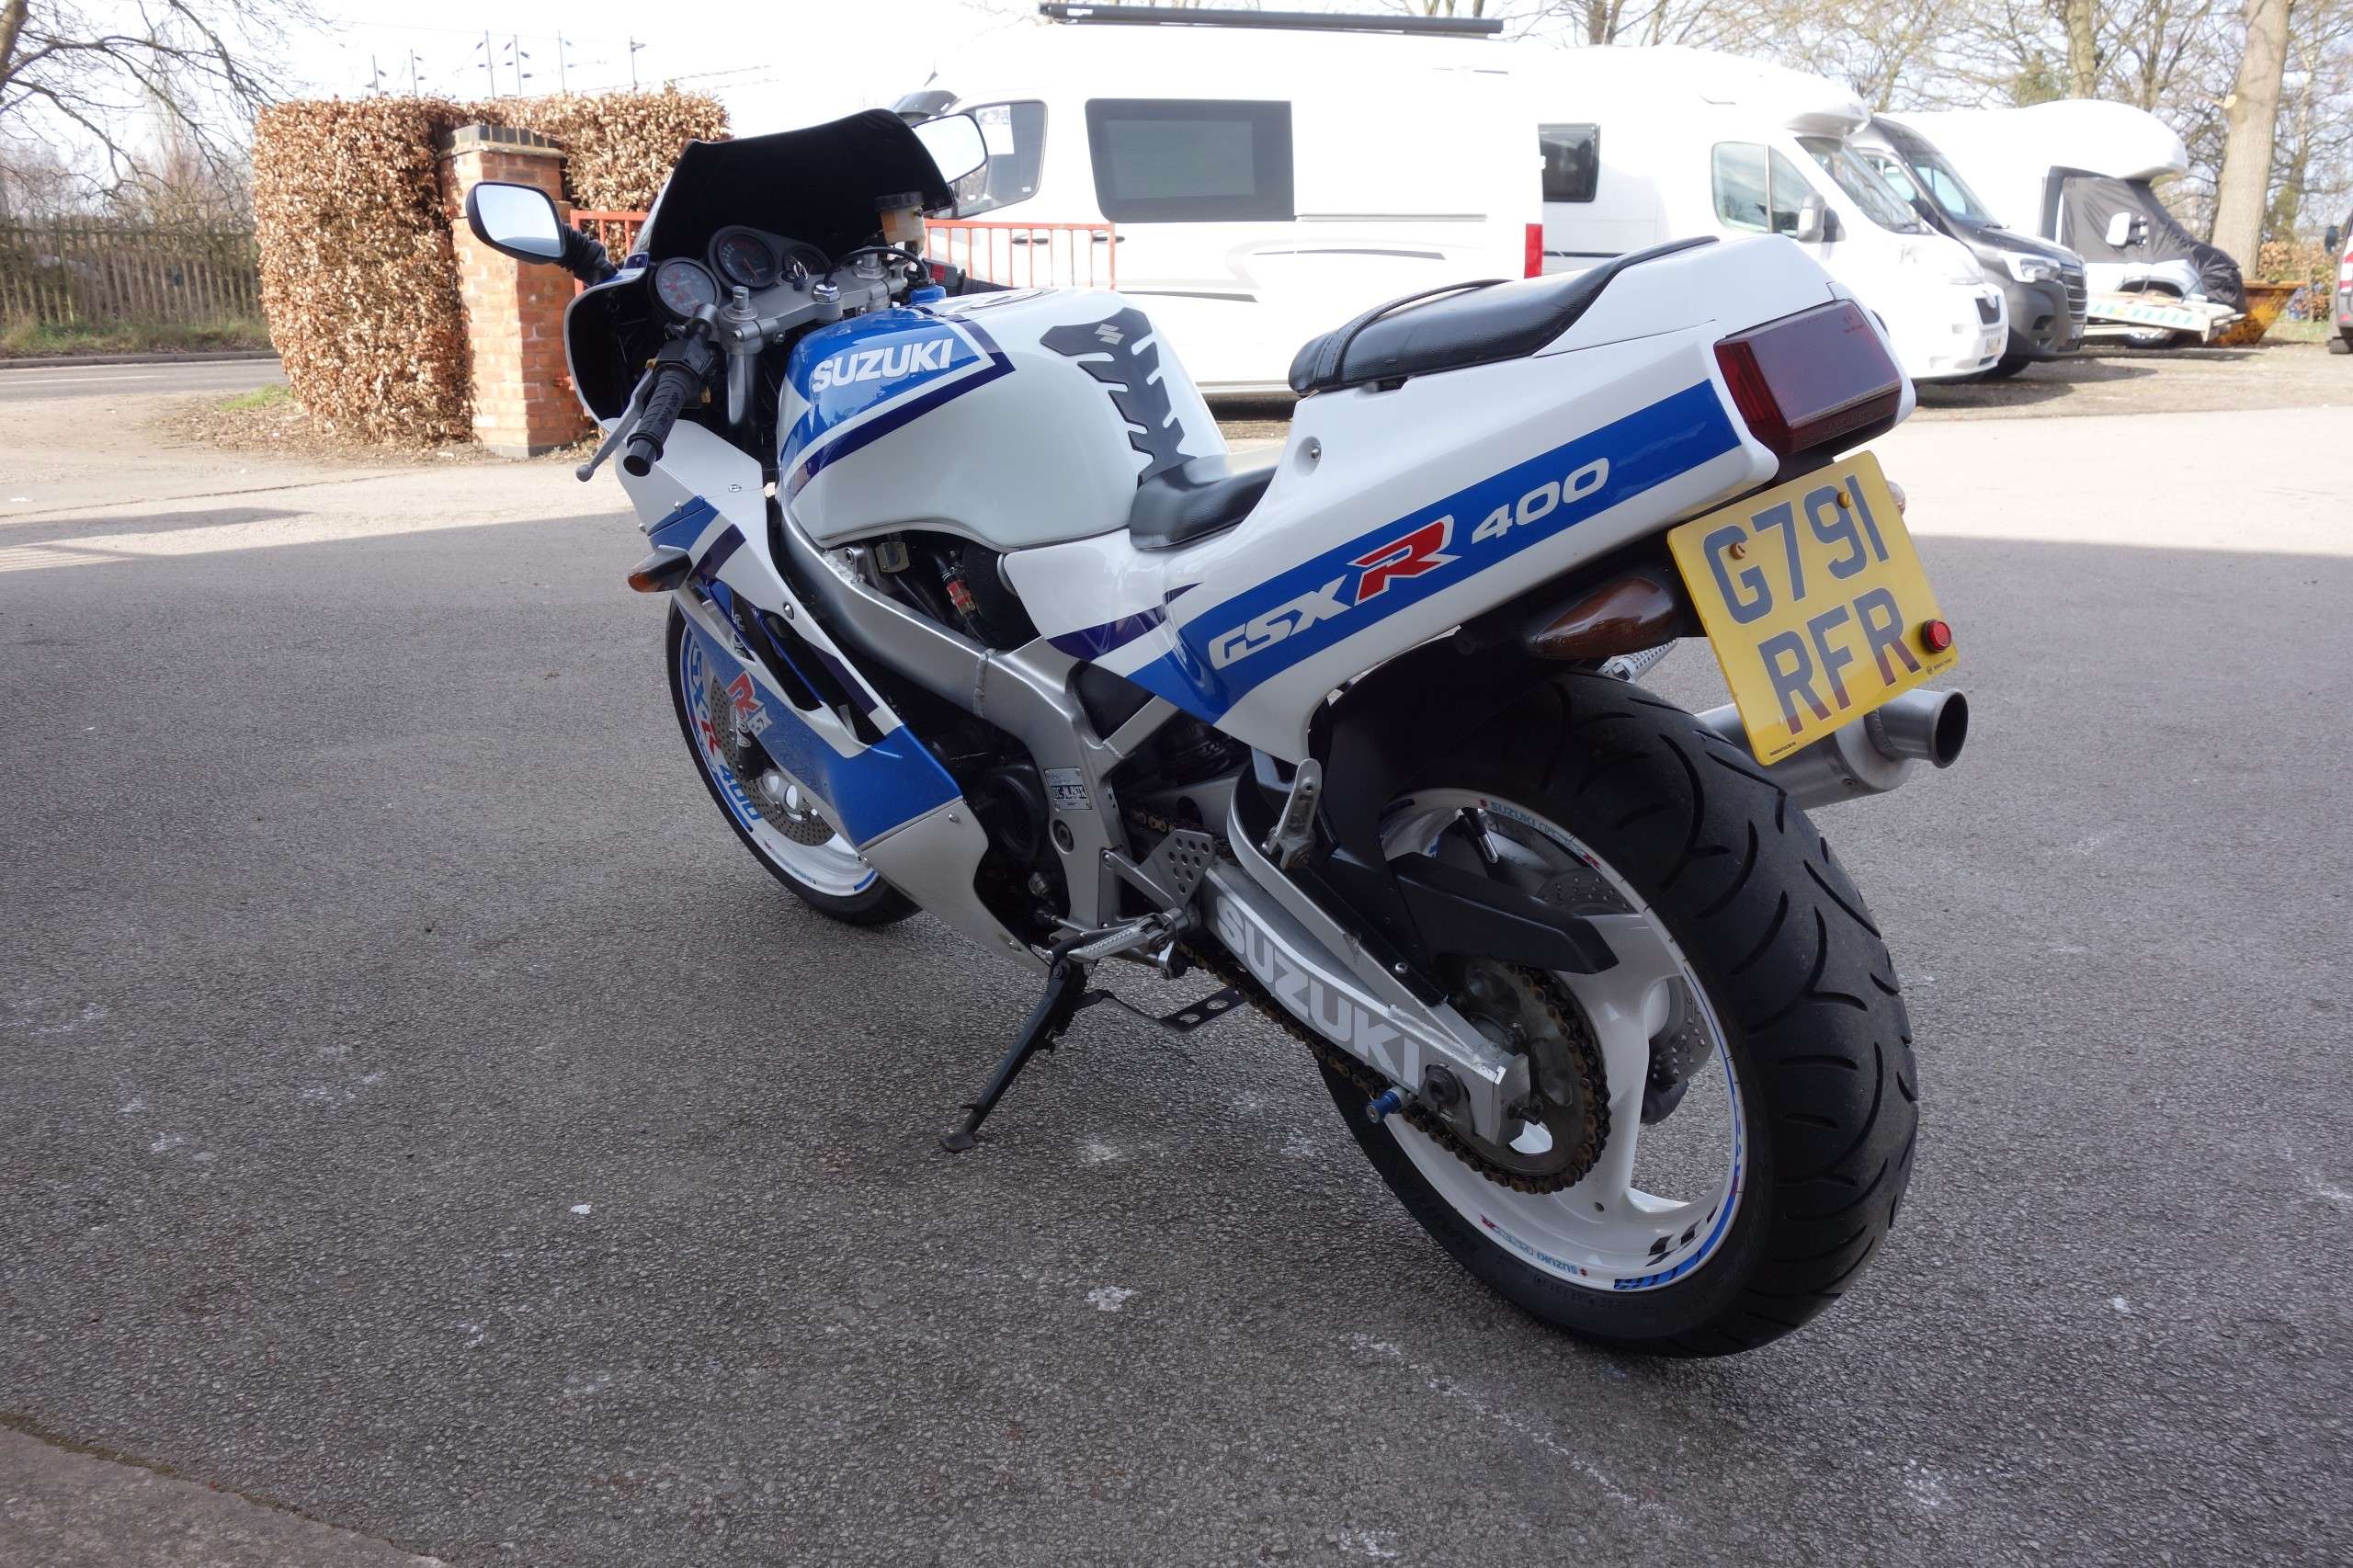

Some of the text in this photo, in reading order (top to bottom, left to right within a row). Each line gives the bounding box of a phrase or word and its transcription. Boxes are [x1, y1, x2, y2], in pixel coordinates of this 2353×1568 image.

[813, 338, 953, 392] SUZUKI
[1472, 458, 1609, 544] 400
[1703, 474, 1889, 625] G791
[1757, 587, 1921, 735] RFR
[1491, 801, 1536, 826] SUZUKI
[1217, 896, 1420, 1089] SUZUKI
[1537, 1251, 1578, 1275] SUZUKI
